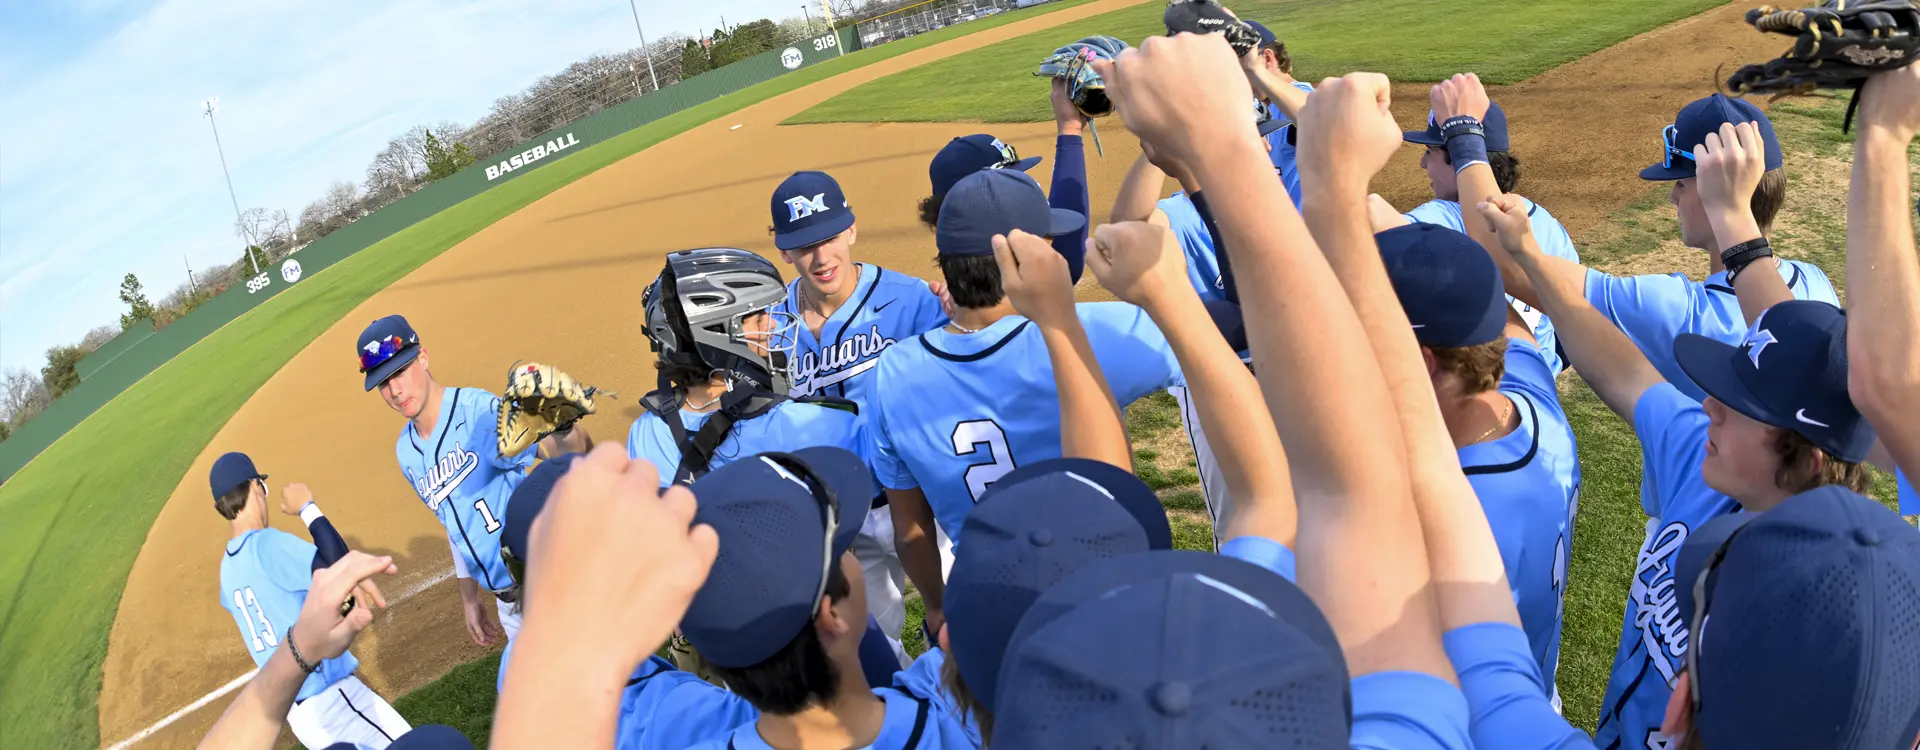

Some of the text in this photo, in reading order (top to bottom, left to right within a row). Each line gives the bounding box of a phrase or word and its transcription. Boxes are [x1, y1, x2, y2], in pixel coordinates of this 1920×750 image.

[813, 34, 836, 51] 318
[485, 132, 580, 181] BASEBALL
[246, 271, 271, 294] 395
[950, 418, 1017, 505] 2
[474, 498, 502, 534] 1
[233, 585, 279, 653] 13
